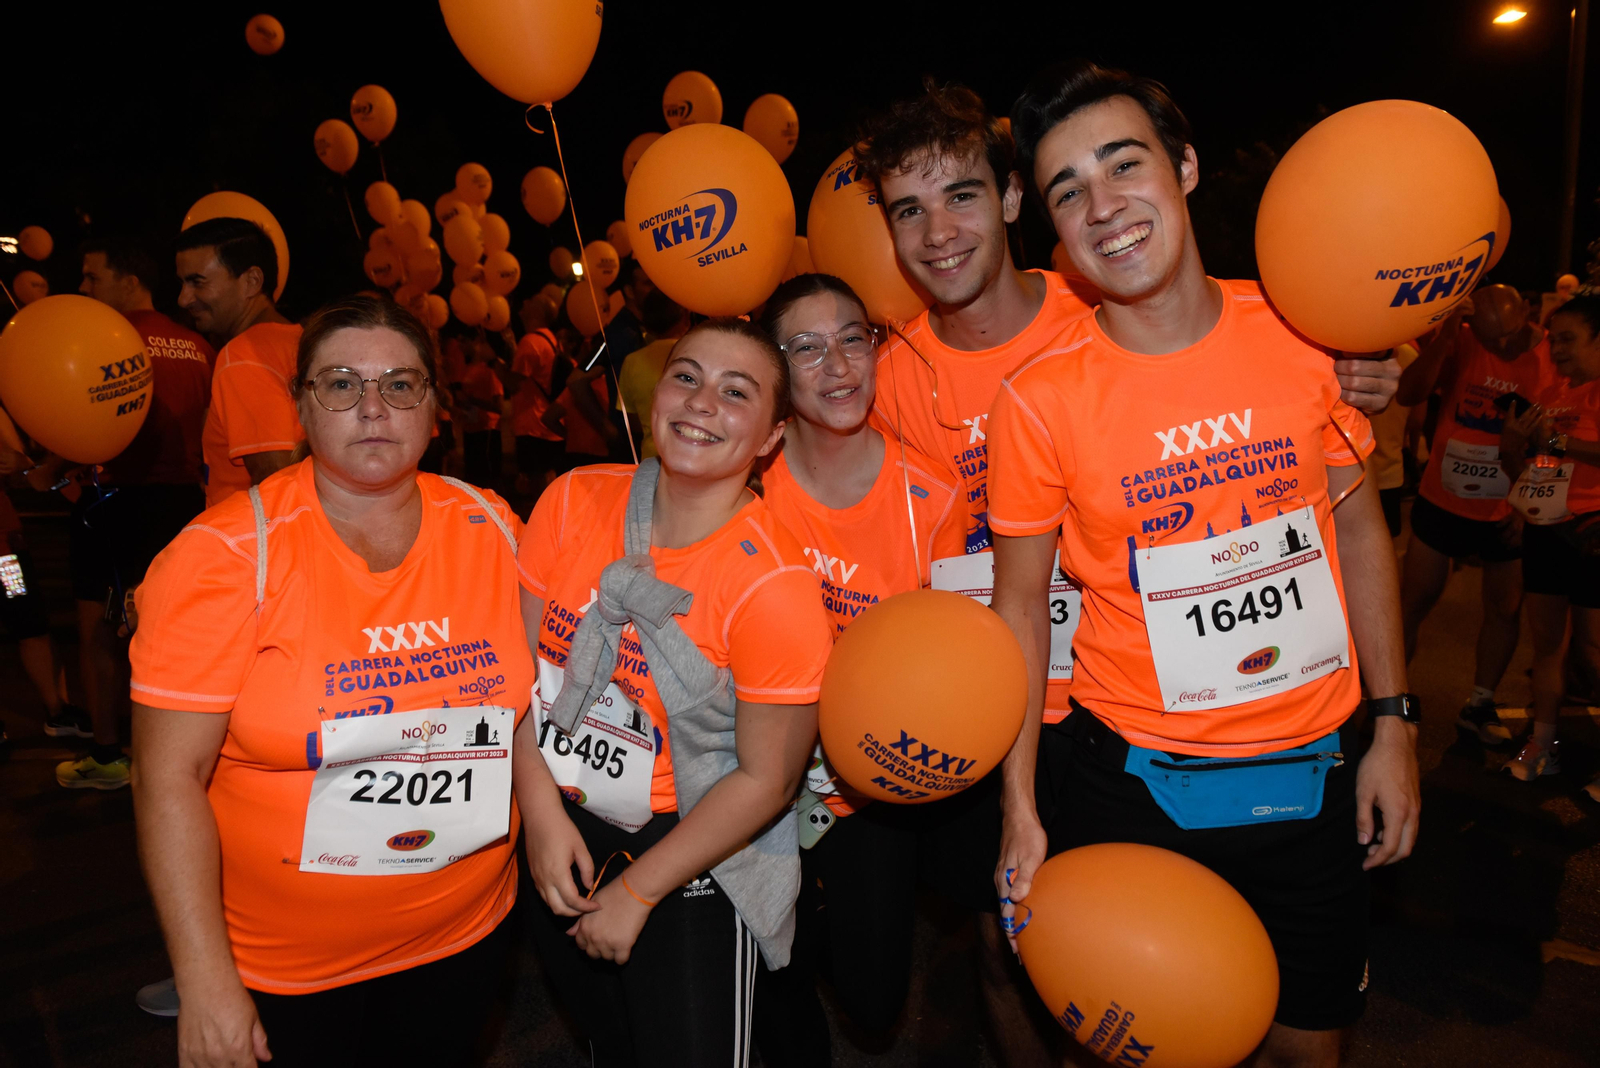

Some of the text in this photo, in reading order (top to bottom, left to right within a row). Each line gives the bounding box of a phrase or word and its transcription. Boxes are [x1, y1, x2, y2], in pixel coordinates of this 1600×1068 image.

[639, 203, 691, 232] NOCTURNA
[697, 242, 748, 268] SEVILLA
[1375, 256, 1464, 281] NOCTURNA
[147, 347, 208, 364] OS ROSALES
[148, 335, 196, 351] COLEGIO
[100, 352, 146, 382] XXXV
[88, 380, 128, 394] CARRERA
[1484, 376, 1519, 393] XXXV
[1154, 408, 1252, 461] XXXV
[1121, 437, 1295, 488] CARRERA NOCTURNA
[1452, 461, 1499, 479] 22022
[1137, 452, 1299, 503] GUADALQUIVIR
[1124, 489, 1136, 508] DEL
[1518, 485, 1556, 499] 17765
[967, 538, 989, 554] 2023
[1151, 552, 1318, 600] XXXV CARRERA NOCTURNA DEL GUADALQUIVIR KH7 2023
[821, 579, 879, 604] NOCTURNA
[1185, 577, 1304, 637] 16491
[362, 616, 450, 654] XXXV
[325, 639, 493, 676] CARRERA NOCTURNA
[1300, 654, 1341, 675] Cruzcampo
[339, 652, 500, 693] GUADALQUIVIR
[326, 678, 335, 697] DEL
[382, 754, 421, 762] NOCTURNA
[429, 751, 476, 760] GUADALQUIVIR
[476, 750, 489, 758] KH7
[489, 750, 504, 758] 2023
[538, 720, 628, 779] 16495
[864, 733, 976, 784] CARRERA NOCTURNA
[889, 729, 977, 776] XXXV
[350, 768, 473, 807] 22021
[683, 888, 716, 898] adidas
